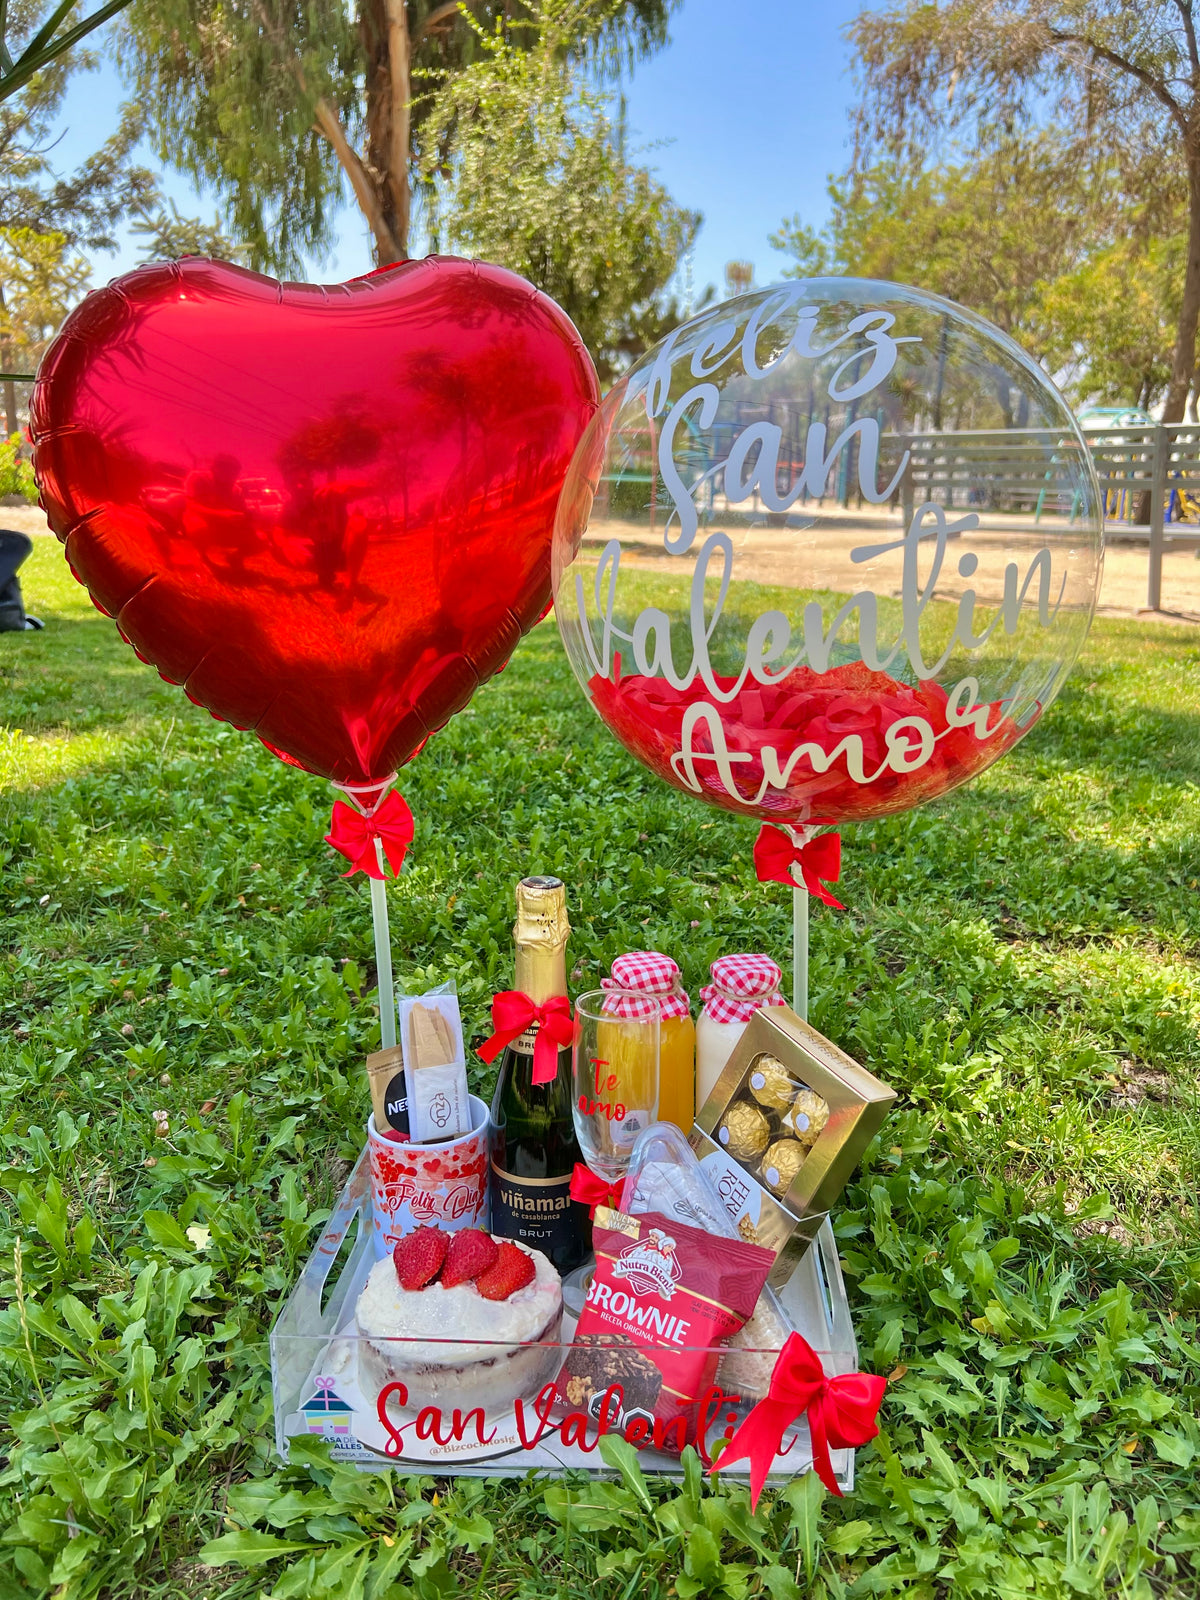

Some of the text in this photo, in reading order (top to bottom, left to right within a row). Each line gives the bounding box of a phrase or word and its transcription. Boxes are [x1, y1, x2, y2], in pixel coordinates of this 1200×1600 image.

[659, 383, 911, 555] San
[576, 501, 1067, 703] Valentin
[670, 676, 1021, 806] Amor
[518, 1040, 535, 1049] BR
[590, 1058, 620, 1096] Te
[387, 1097, 408, 1116] NES
[578, 1095, 629, 1121] amo
[718, 1168, 738, 1201] RO
[725, 1180, 751, 1217] FER
[385, 1183, 442, 1220] Feliz
[511, 1210, 560, 1220] de casablanca
[519, 1229, 553, 1238] BRUT
[609, 1211, 638, 1227] NUEVA
[619, 1260, 649, 1273] Nutra
[586, 1279, 691, 1346] BROWNIE
[600, 1311, 654, 1343] RECETA ORIGINAL
[377, 1382, 798, 1464] San Valenti
